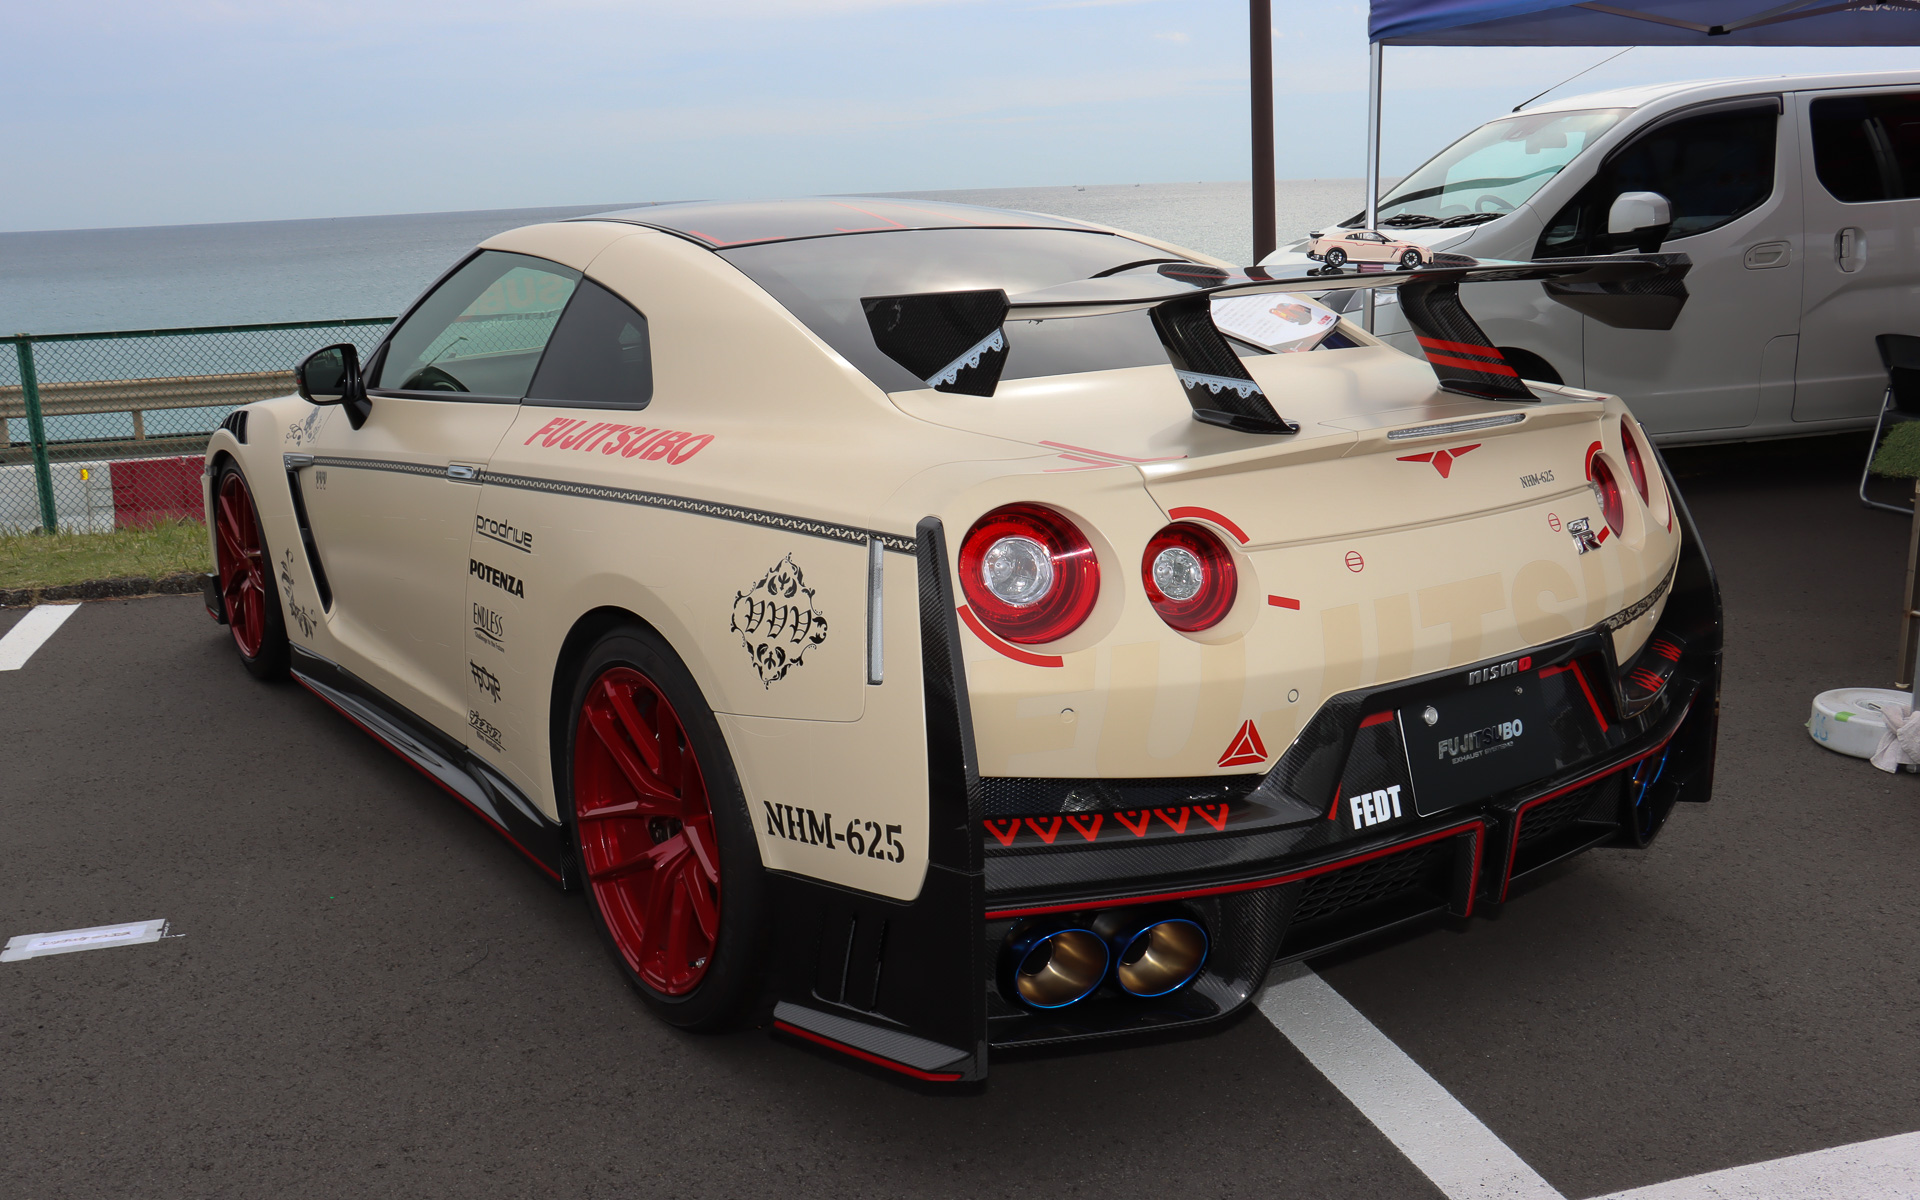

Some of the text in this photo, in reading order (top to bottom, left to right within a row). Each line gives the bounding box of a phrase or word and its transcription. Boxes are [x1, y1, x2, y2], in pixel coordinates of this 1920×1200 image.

[523, 416, 716, 466] FUJITSUBO
[1519, 469, 1555, 490] NHM-625
[469, 558, 525, 599] POTENZA
[473, 602, 504, 637] ENDLESS
[1438, 718, 1523, 760] FUJITSUBO
[1452, 749, 1484, 765] EXHAUST
[1350, 784, 1402, 830] FEDT
[763, 800, 905, 863] NHM-625
